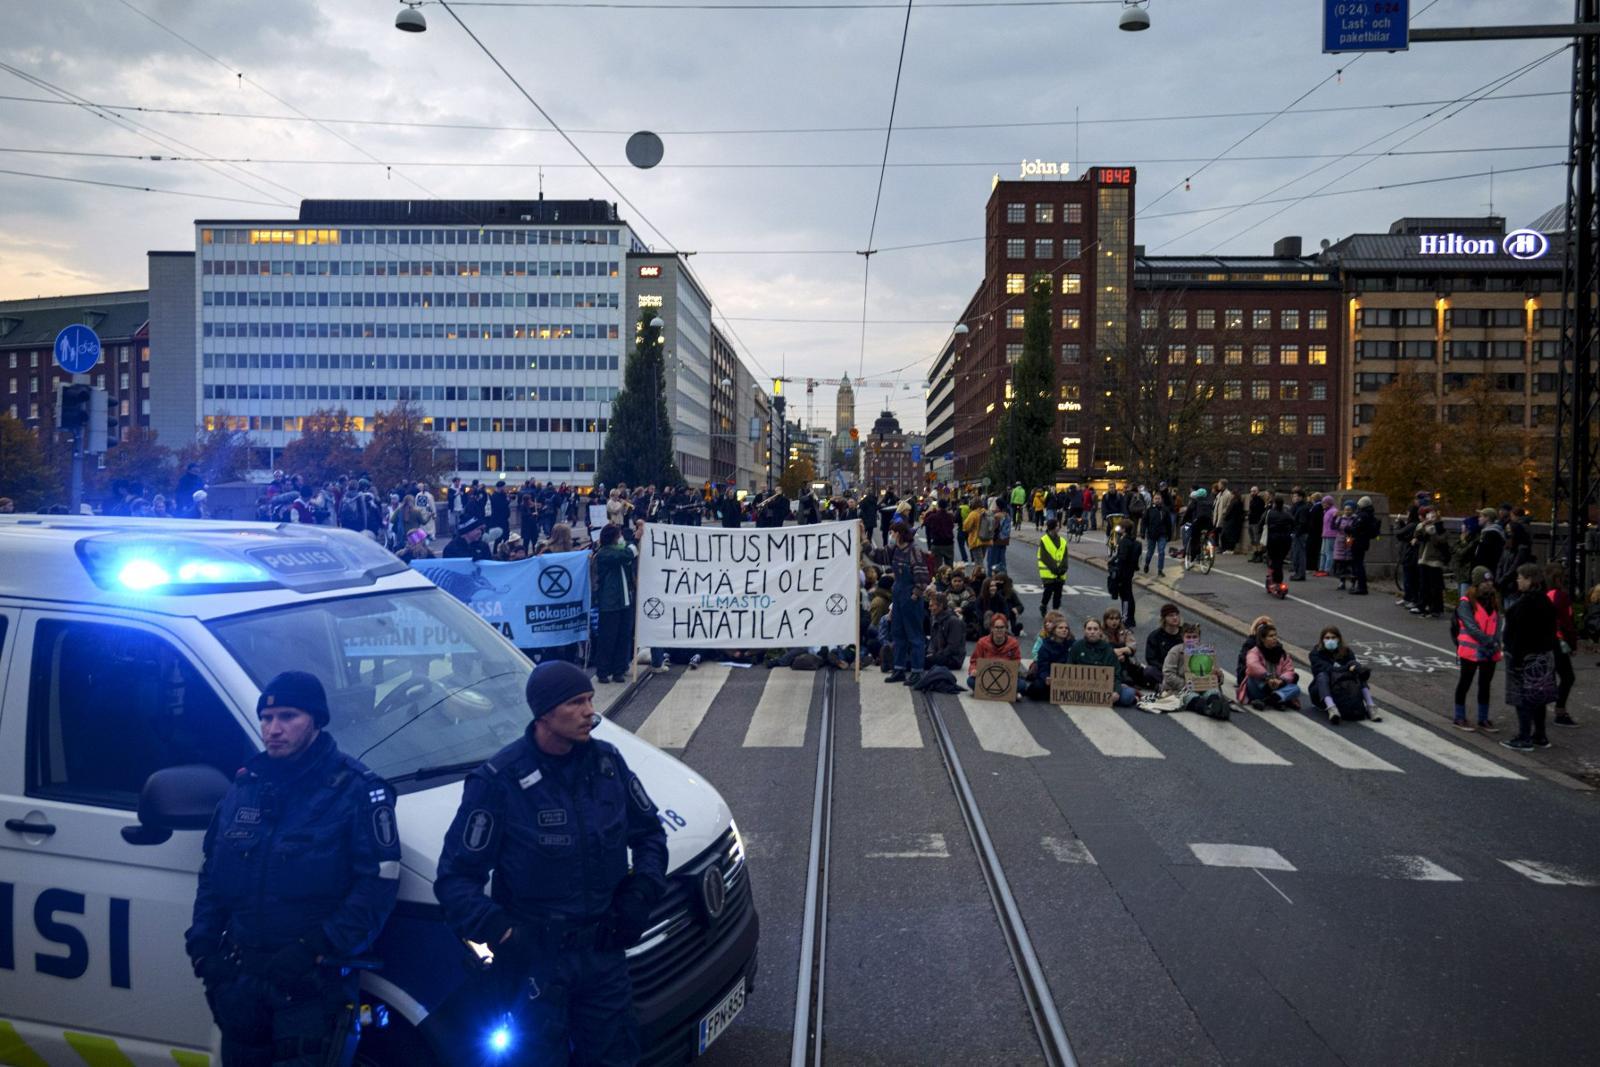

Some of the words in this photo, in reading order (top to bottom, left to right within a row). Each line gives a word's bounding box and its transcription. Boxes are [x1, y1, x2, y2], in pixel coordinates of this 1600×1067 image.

[1372, 18, 1391, 29] och
[1339, 31, 1390, 44] paketbilar
[1419, 233, 1496, 254] Hilton
[767, 529, 852, 562] MITEN
[263, 551, 336, 568] POLIISI
[661, 567, 734, 594] TÄMÄ
[778, 567, 825, 593] OLE
[672, 604, 814, 640] HÄTÄTILA?
